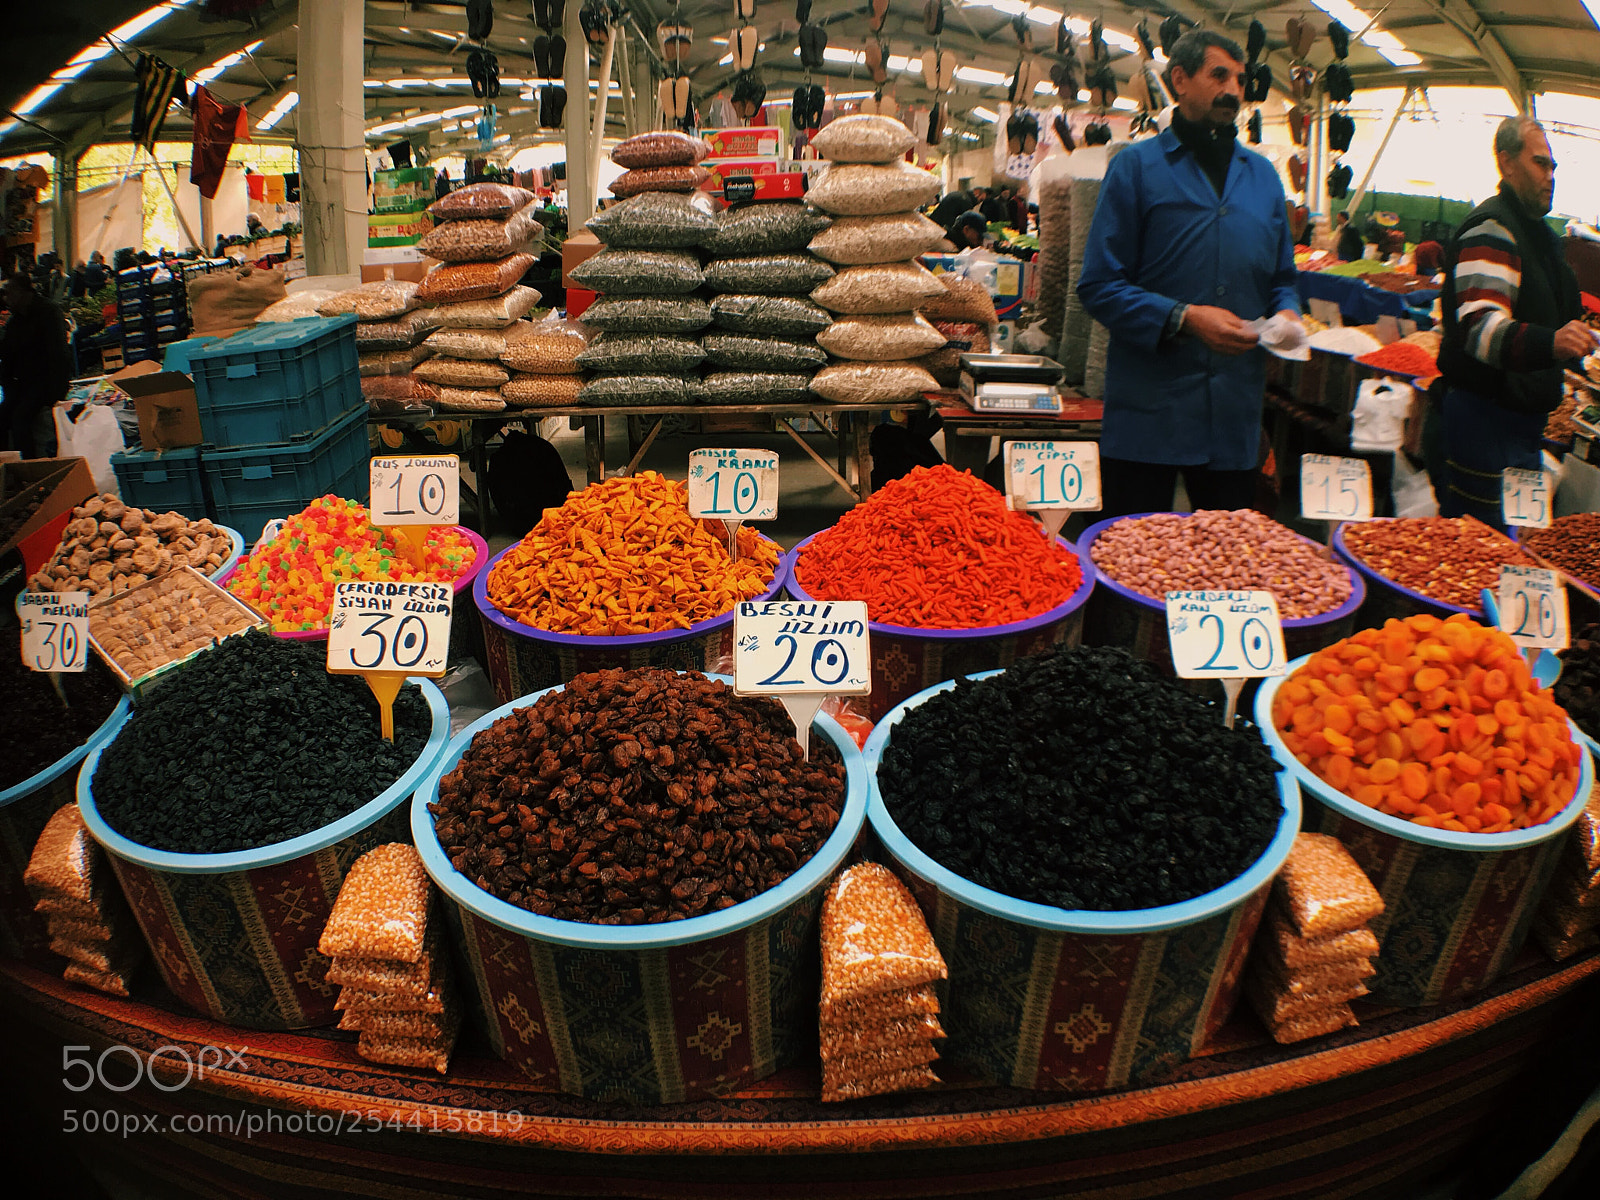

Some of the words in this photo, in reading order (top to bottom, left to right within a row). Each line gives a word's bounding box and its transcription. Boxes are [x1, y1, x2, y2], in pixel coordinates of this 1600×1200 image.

[373, 459, 399, 469] KUŞ
[1013, 442, 1055, 451] MISIR
[382, 472, 446, 515] 10
[699, 471, 759, 514] 10
[1026, 463, 1083, 504] 10
[1315, 475, 1360, 517] 15
[1509, 489, 1547, 522] 15
[337, 581, 450, 602] ÇEKİRDEKSİZ
[338, 596, 393, 611] SİYAH
[402, 599, 451, 617] ÜZÜM
[740, 602, 835, 619] BESNİ
[778, 618, 864, 637] ÜZÜM
[1509, 590, 1557, 639] 20
[36, 621, 80, 670] 30
[349, 611, 429, 668] 30
[755, 634, 850, 685] 20
[1191, 613, 1274, 670] 20
